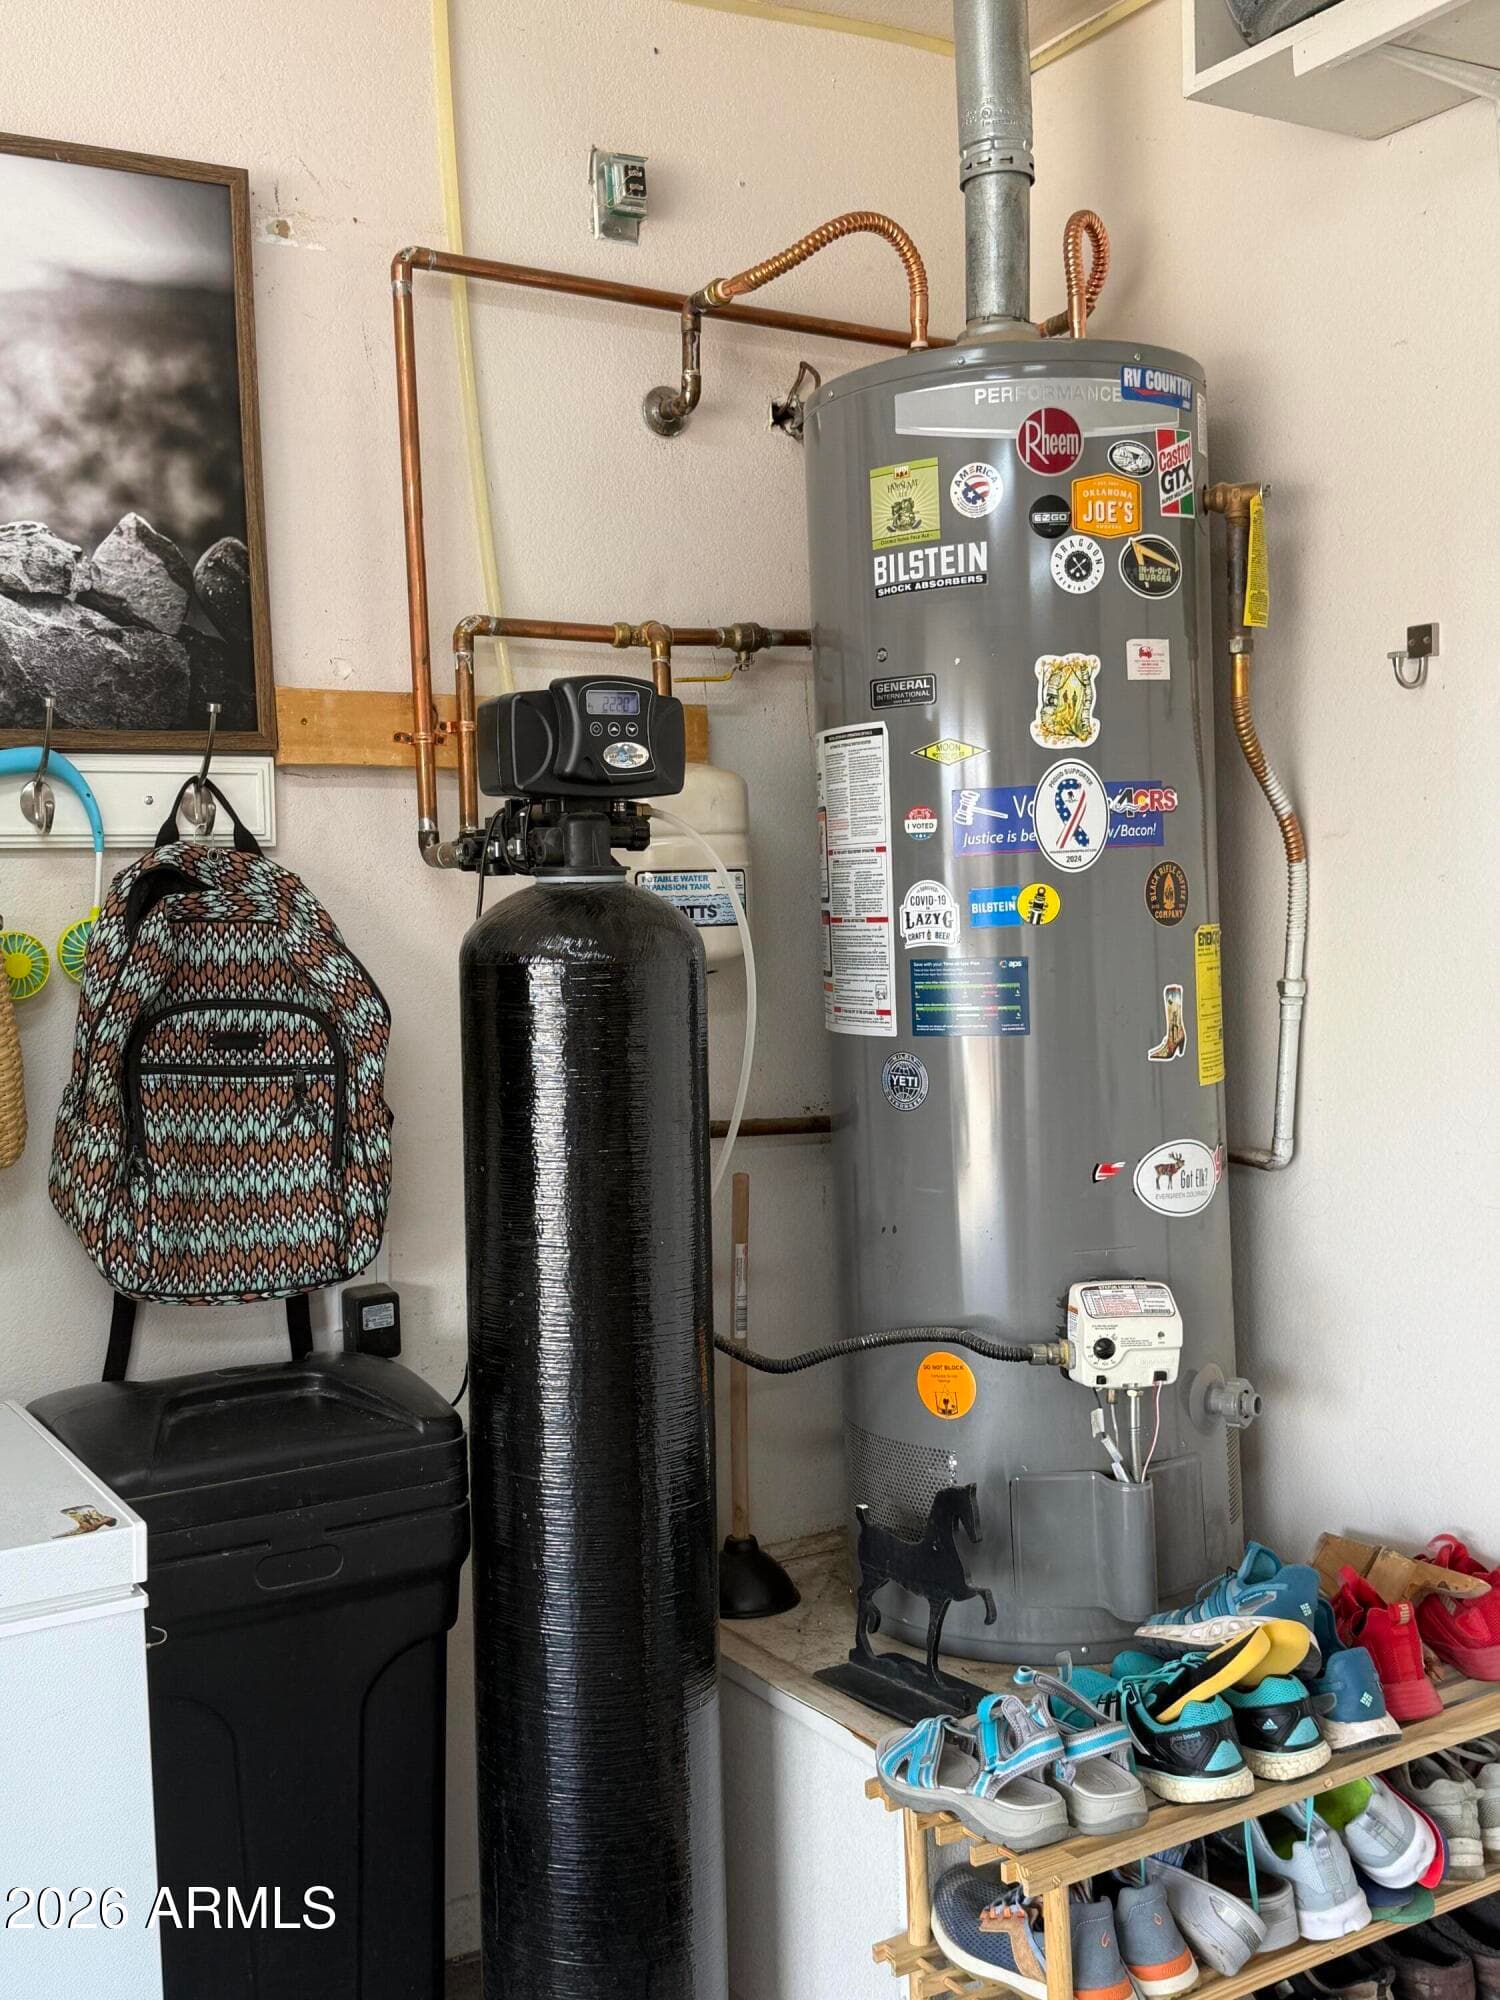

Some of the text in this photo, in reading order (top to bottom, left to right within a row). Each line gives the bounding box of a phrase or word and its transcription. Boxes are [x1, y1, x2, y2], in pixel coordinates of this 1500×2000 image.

[1123, 367, 1192, 399] RV COUNTRY
[974, 383, 1122, 405] PERFORMANCE
[1025, 409, 1079, 465] Rheem
[1159, 441, 1191, 472] Castrol
[954, 465, 998, 488] AMERICA
[1161, 460, 1192, 495] GTX
[1082, 488, 1133, 500] OKLAHOMA
[1083, 500, 1134, 524] JOE'S
[1055, 538, 1104, 565] DRAGOON
[873, 541, 988, 586] BILSTEIN
[878, 575, 984, 597] SHOCK ABSORBERS
[1138, 573, 1172, 583] BURGER
[876, 679, 931, 694] GENERAL
[876, 690, 931, 701] INTERNATIONAL
[936, 743, 961, 752] MOON
[1048, 768, 1094, 788] PROUD SUPPORTER
[912, 822, 934, 830] VOTED
[962, 830, 1004, 848] Justice
[1007, 829, 1017, 843] is
[1066, 855, 1082, 863] 2024
[680, 874, 709, 882] WATER
[1150, 872, 1160, 901] BLACK
[1159, 864, 1176, 876] RIFLE
[910, 895, 947, 906] COVID-19
[971, 898, 1016, 914] BILSTEIN
[675, 904, 717, 919] ATTS
[905, 910, 954, 930] LAZY G
[1155, 909, 1183, 919] COMPANY
[908, 931, 925, 941] CRAFT
[1008, 960, 1022, 968] aps
[891, 1075, 918, 1087] YETI
[1180, 1167, 1208, 1189] Got Elk?
